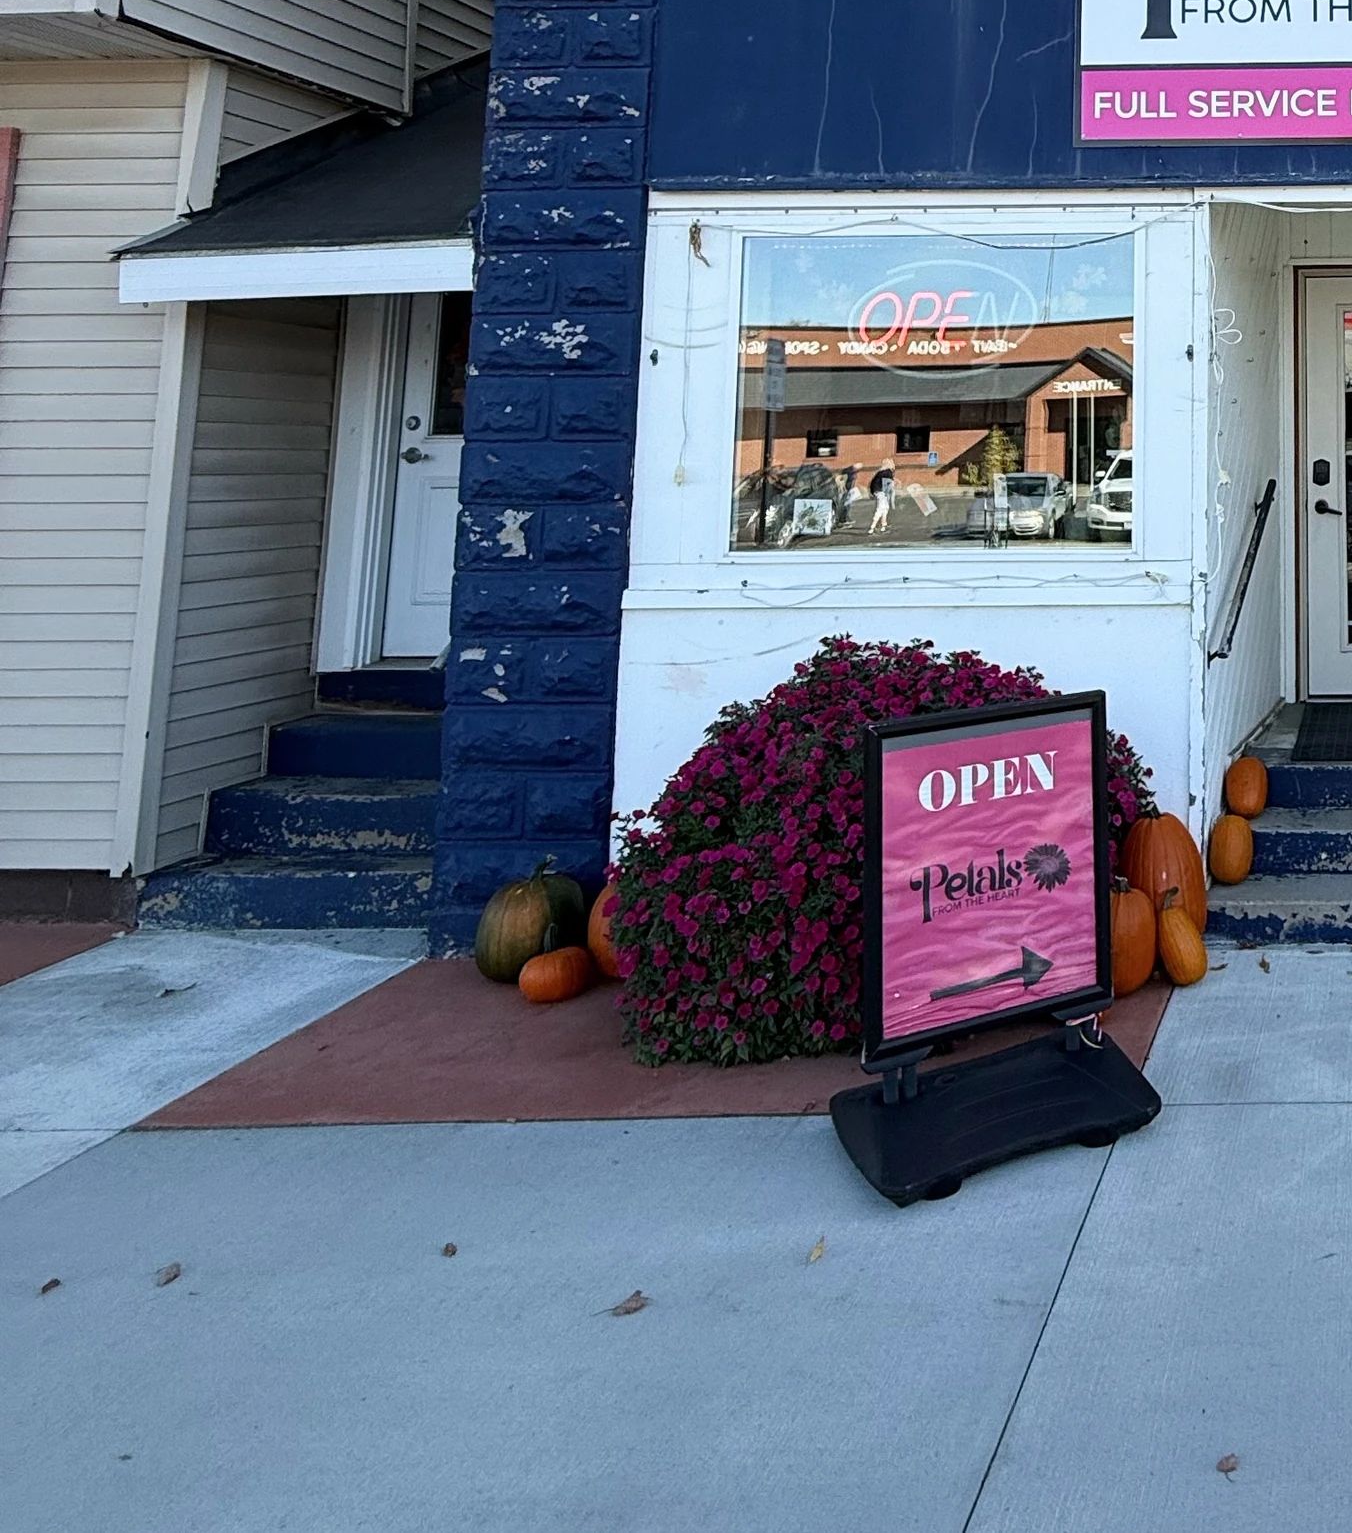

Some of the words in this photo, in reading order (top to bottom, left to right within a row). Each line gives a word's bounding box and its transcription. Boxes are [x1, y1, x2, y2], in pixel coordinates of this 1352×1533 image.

[1093, 90, 1177, 119] FULL
[1187, 88, 1338, 118] SERVICE
[858, 290, 1020, 348] OPEN
[918, 750, 1059, 812] OPEN
[909, 848, 1022, 924] Petals
[932, 902, 961, 917] FROM
[965, 897, 984, 908] THE
[987, 887, 1020, 903] HEART
